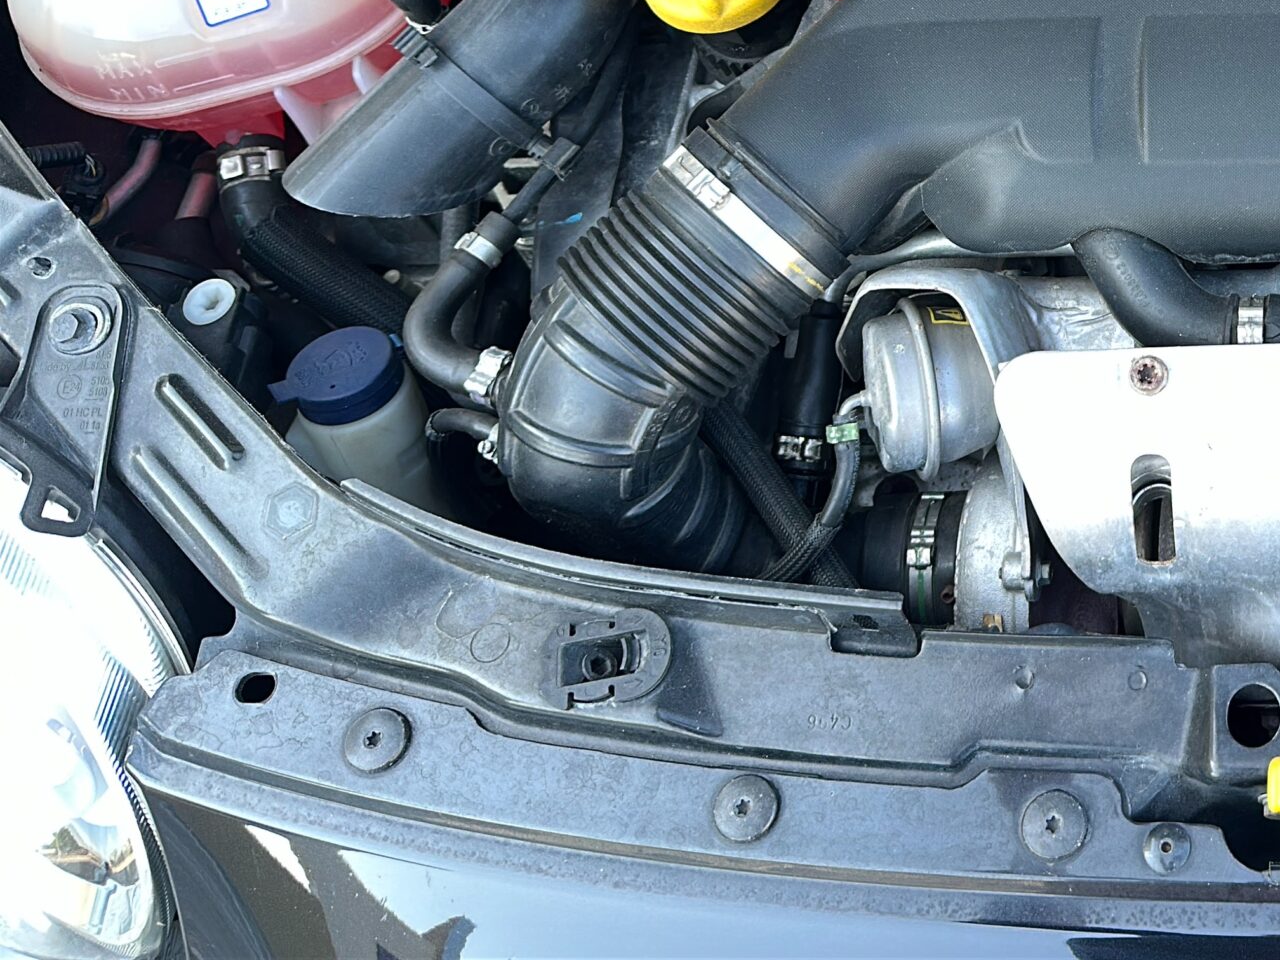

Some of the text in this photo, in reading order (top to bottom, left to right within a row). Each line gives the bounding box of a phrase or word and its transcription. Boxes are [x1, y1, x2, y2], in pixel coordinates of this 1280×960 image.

[108, 83, 170, 102] MIN
[75, 407, 90, 417] HC
[90, 407, 103, 417] PL
